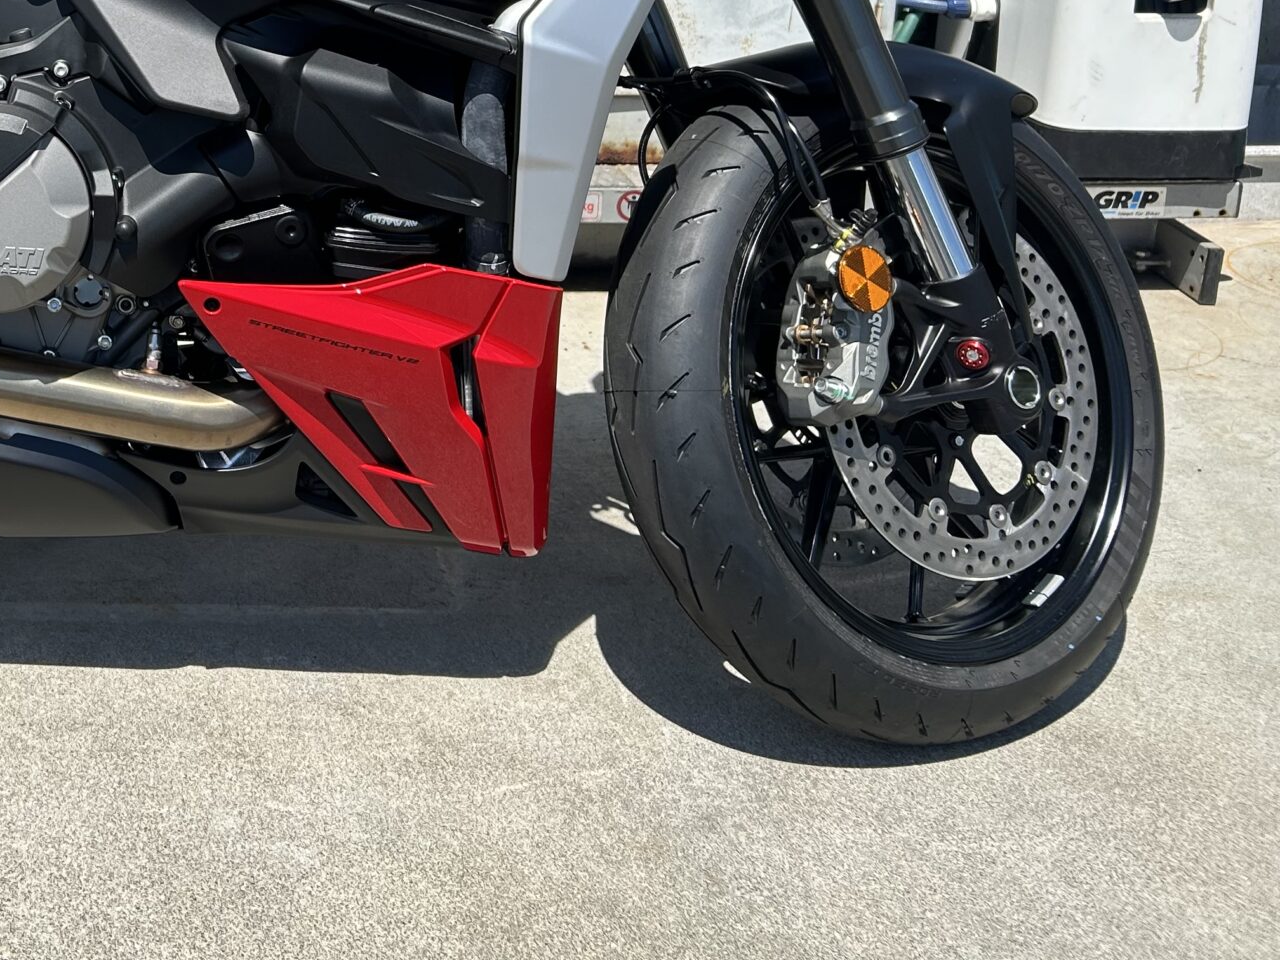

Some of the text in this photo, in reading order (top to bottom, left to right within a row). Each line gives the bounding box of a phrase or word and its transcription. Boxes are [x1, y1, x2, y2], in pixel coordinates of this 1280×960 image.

[249, 319, 420, 364] STREETFIGHTER V2
[860, 310, 883, 381] bremb
